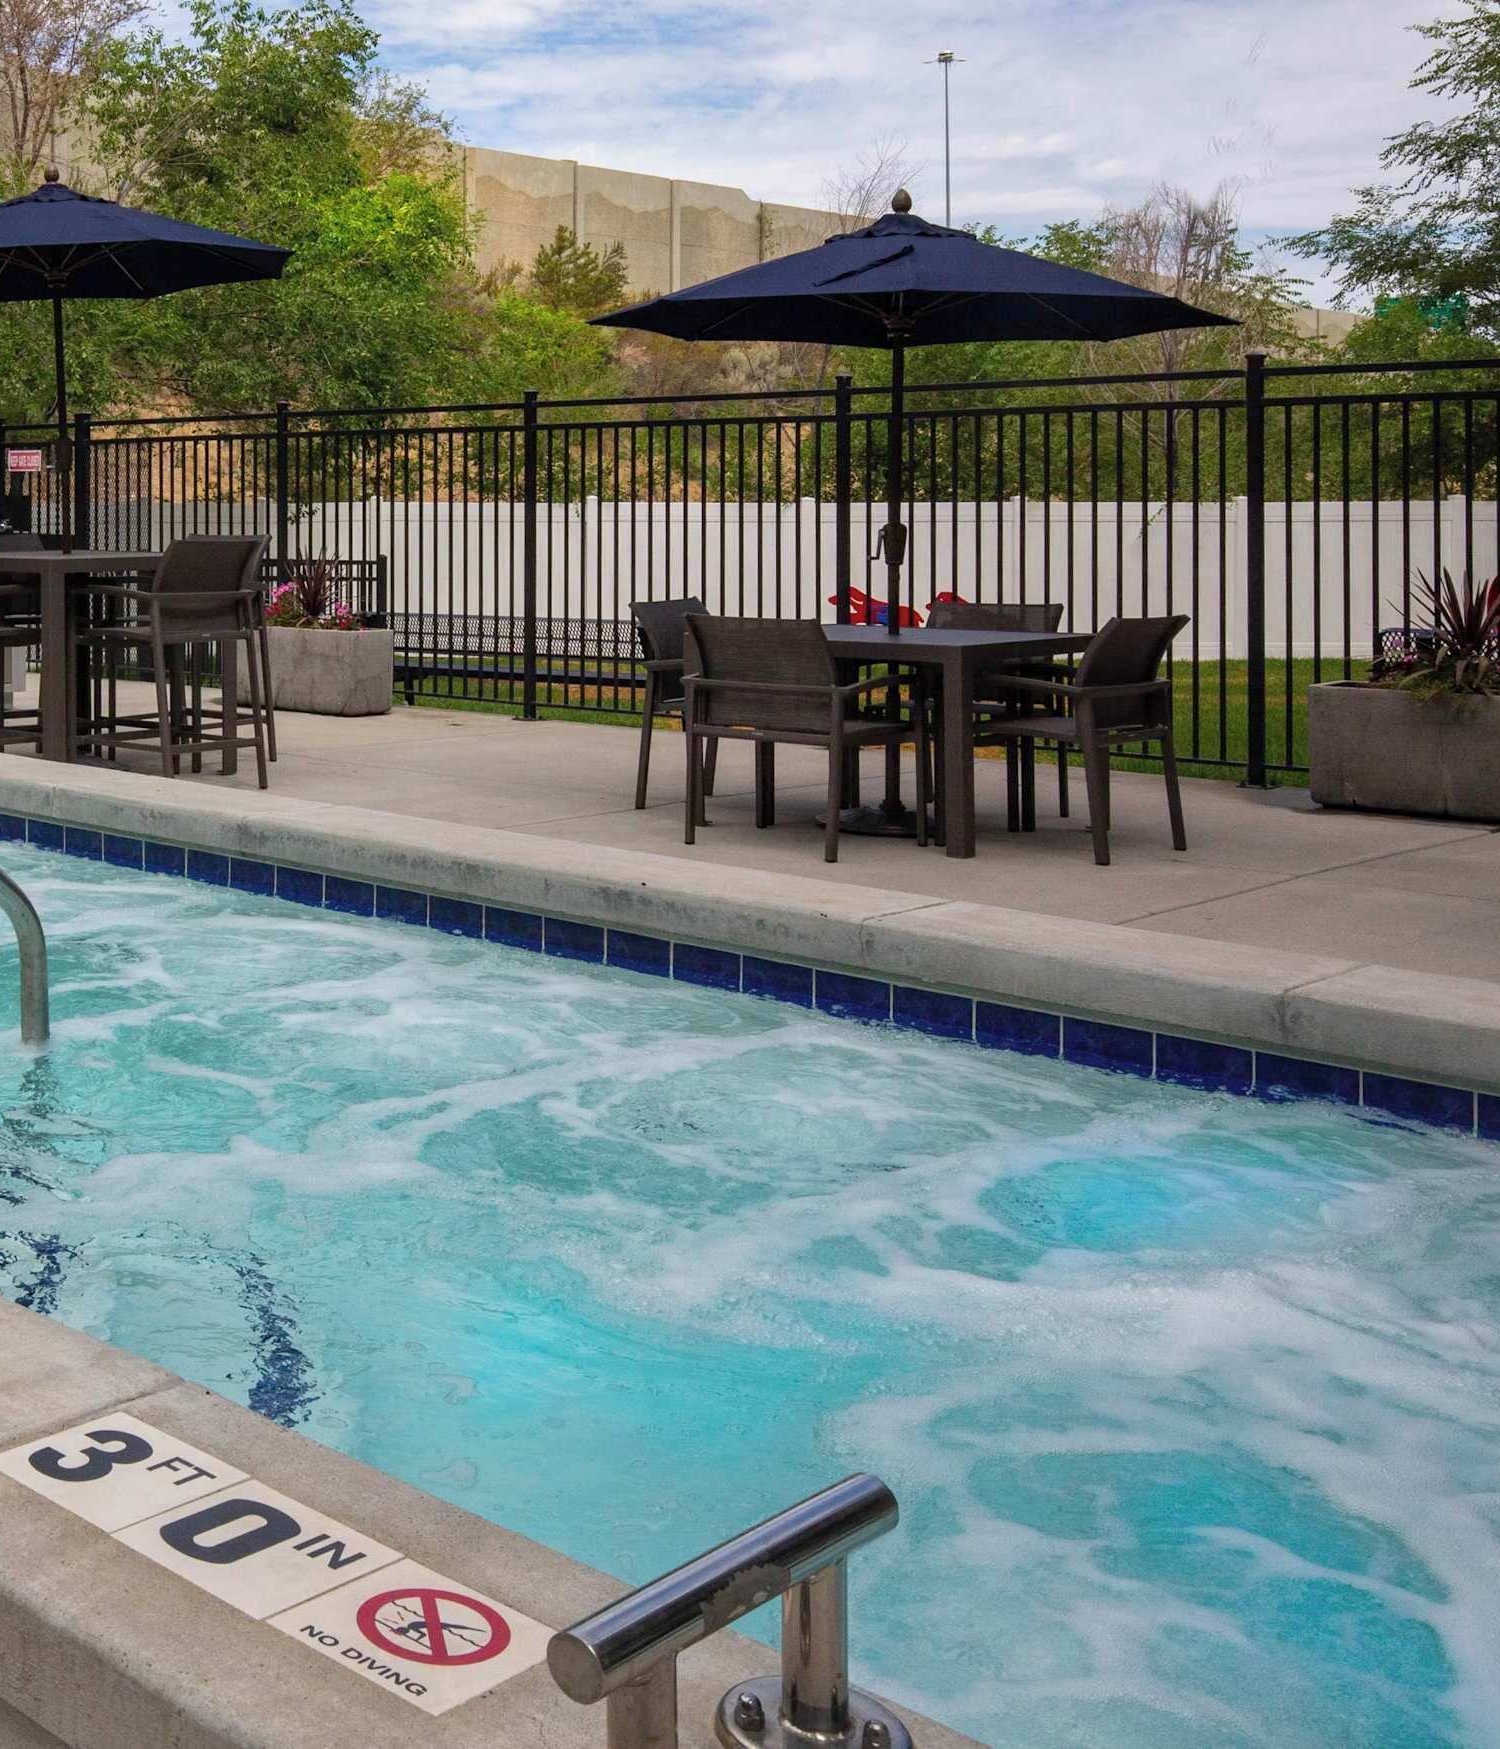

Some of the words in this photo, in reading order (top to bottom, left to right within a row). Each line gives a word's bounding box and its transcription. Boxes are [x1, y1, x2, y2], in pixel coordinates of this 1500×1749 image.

[29, 1430, 154, 1482] 3
[146, 1456, 217, 1487] FT
[159, 1498, 302, 1565] 0
[292, 1533, 368, 1571] IN
[299, 1623, 342, 1648] NO
[340, 1646, 429, 1698] DIVING
